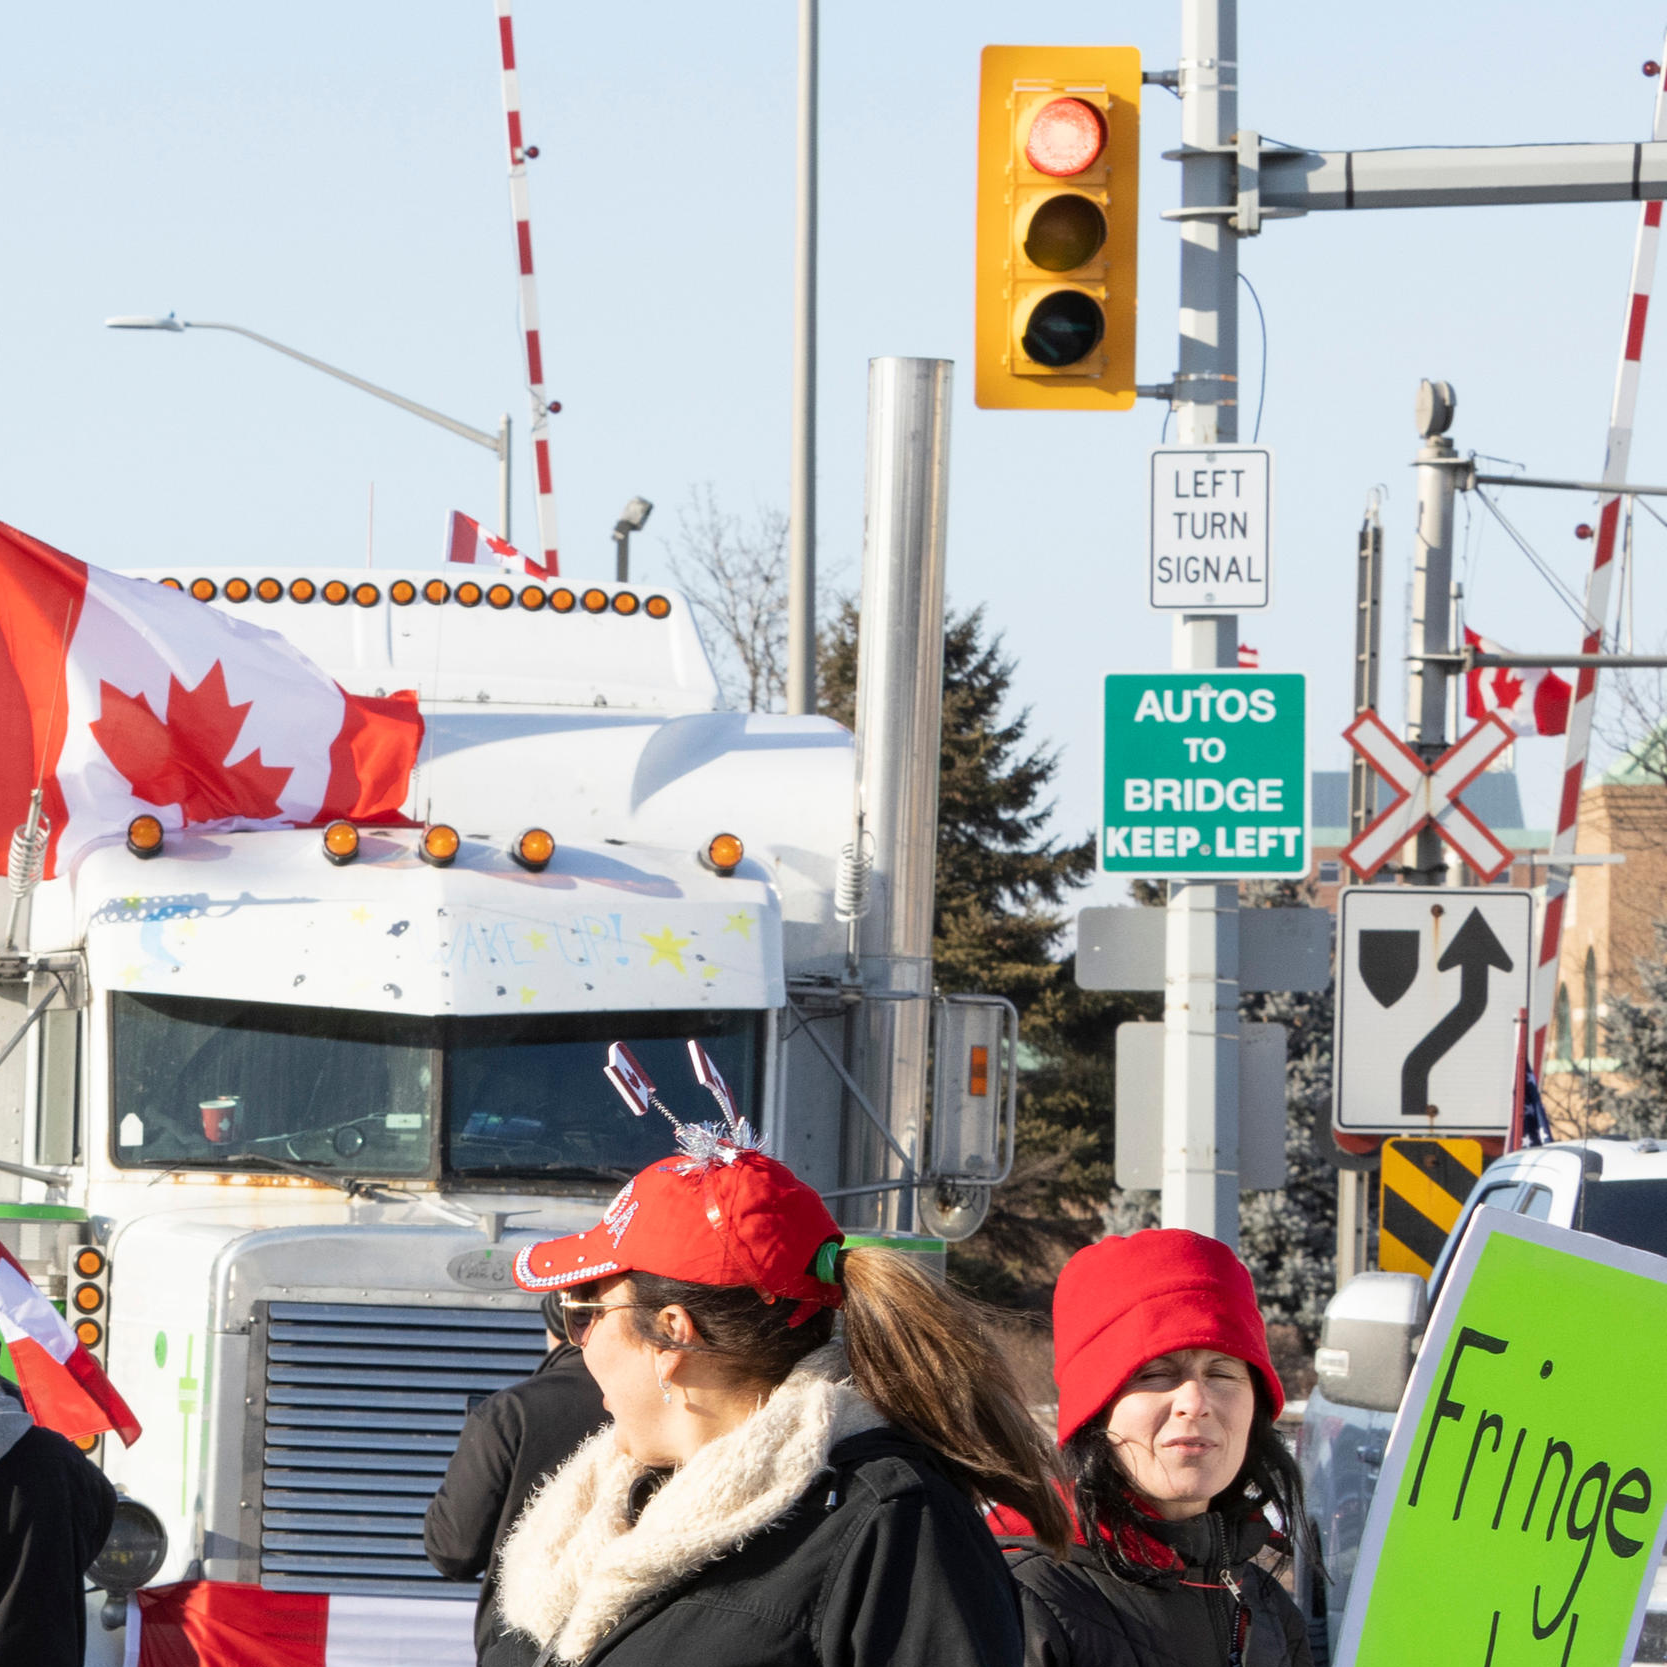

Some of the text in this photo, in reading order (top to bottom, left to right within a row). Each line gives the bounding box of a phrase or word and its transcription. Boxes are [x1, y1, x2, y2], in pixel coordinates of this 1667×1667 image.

[1175, 470, 1245, 498] LEFT
[1173, 512, 1247, 539] TURN
[1157, 556, 1262, 583] SIGNAL
[1133, 688, 1276, 723] AUTOS
[1183, 737, 1226, 763] TO
[1124, 778, 1284, 812] BRIDGE
[1106, 826, 1301, 858] KEEP LEFT
[549, 913, 630, 966] UP!
[1408, 1326, 1651, 1640] Fringe
